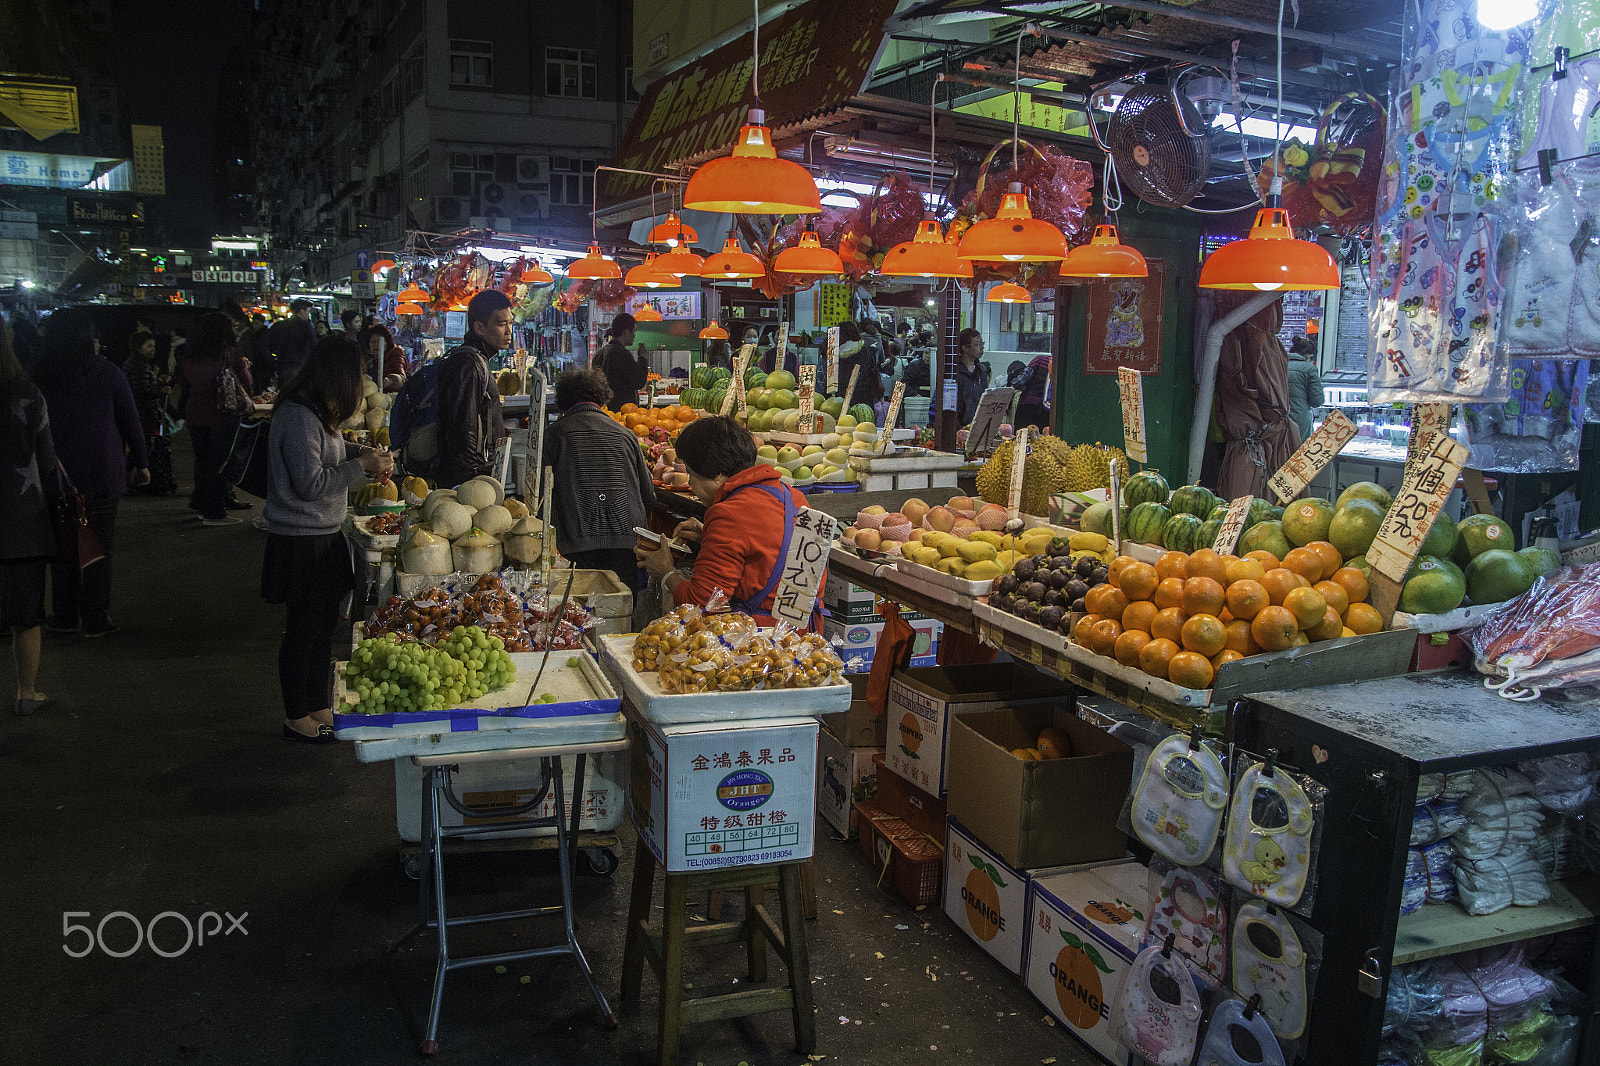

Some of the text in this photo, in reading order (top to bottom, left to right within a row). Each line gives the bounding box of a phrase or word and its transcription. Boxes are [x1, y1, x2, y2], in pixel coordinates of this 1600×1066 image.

[1099, 348, 1147, 361] 恭賀新禧
[899, 722, 923, 741] ORANGE
[691, 748, 796, 771] 金鴻泰果品
[736, 773, 754, 781] HONG
[729, 784, 760, 796] JHT
[727, 796, 766, 807] Oranges
[700, 810, 787, 831] 特级甜橙
[690, 834, 701, 843] 40
[710, 833, 721, 841] 48
[784, 825, 794, 833] 80
[761, 850, 792, 860] 69183054
[961, 886, 1006, 932] ORANGE
[1087, 900, 1128, 927] ORANGE
[1049, 961, 1110, 1021] ORANGE
[1147, 1003, 1170, 1026] Baby
